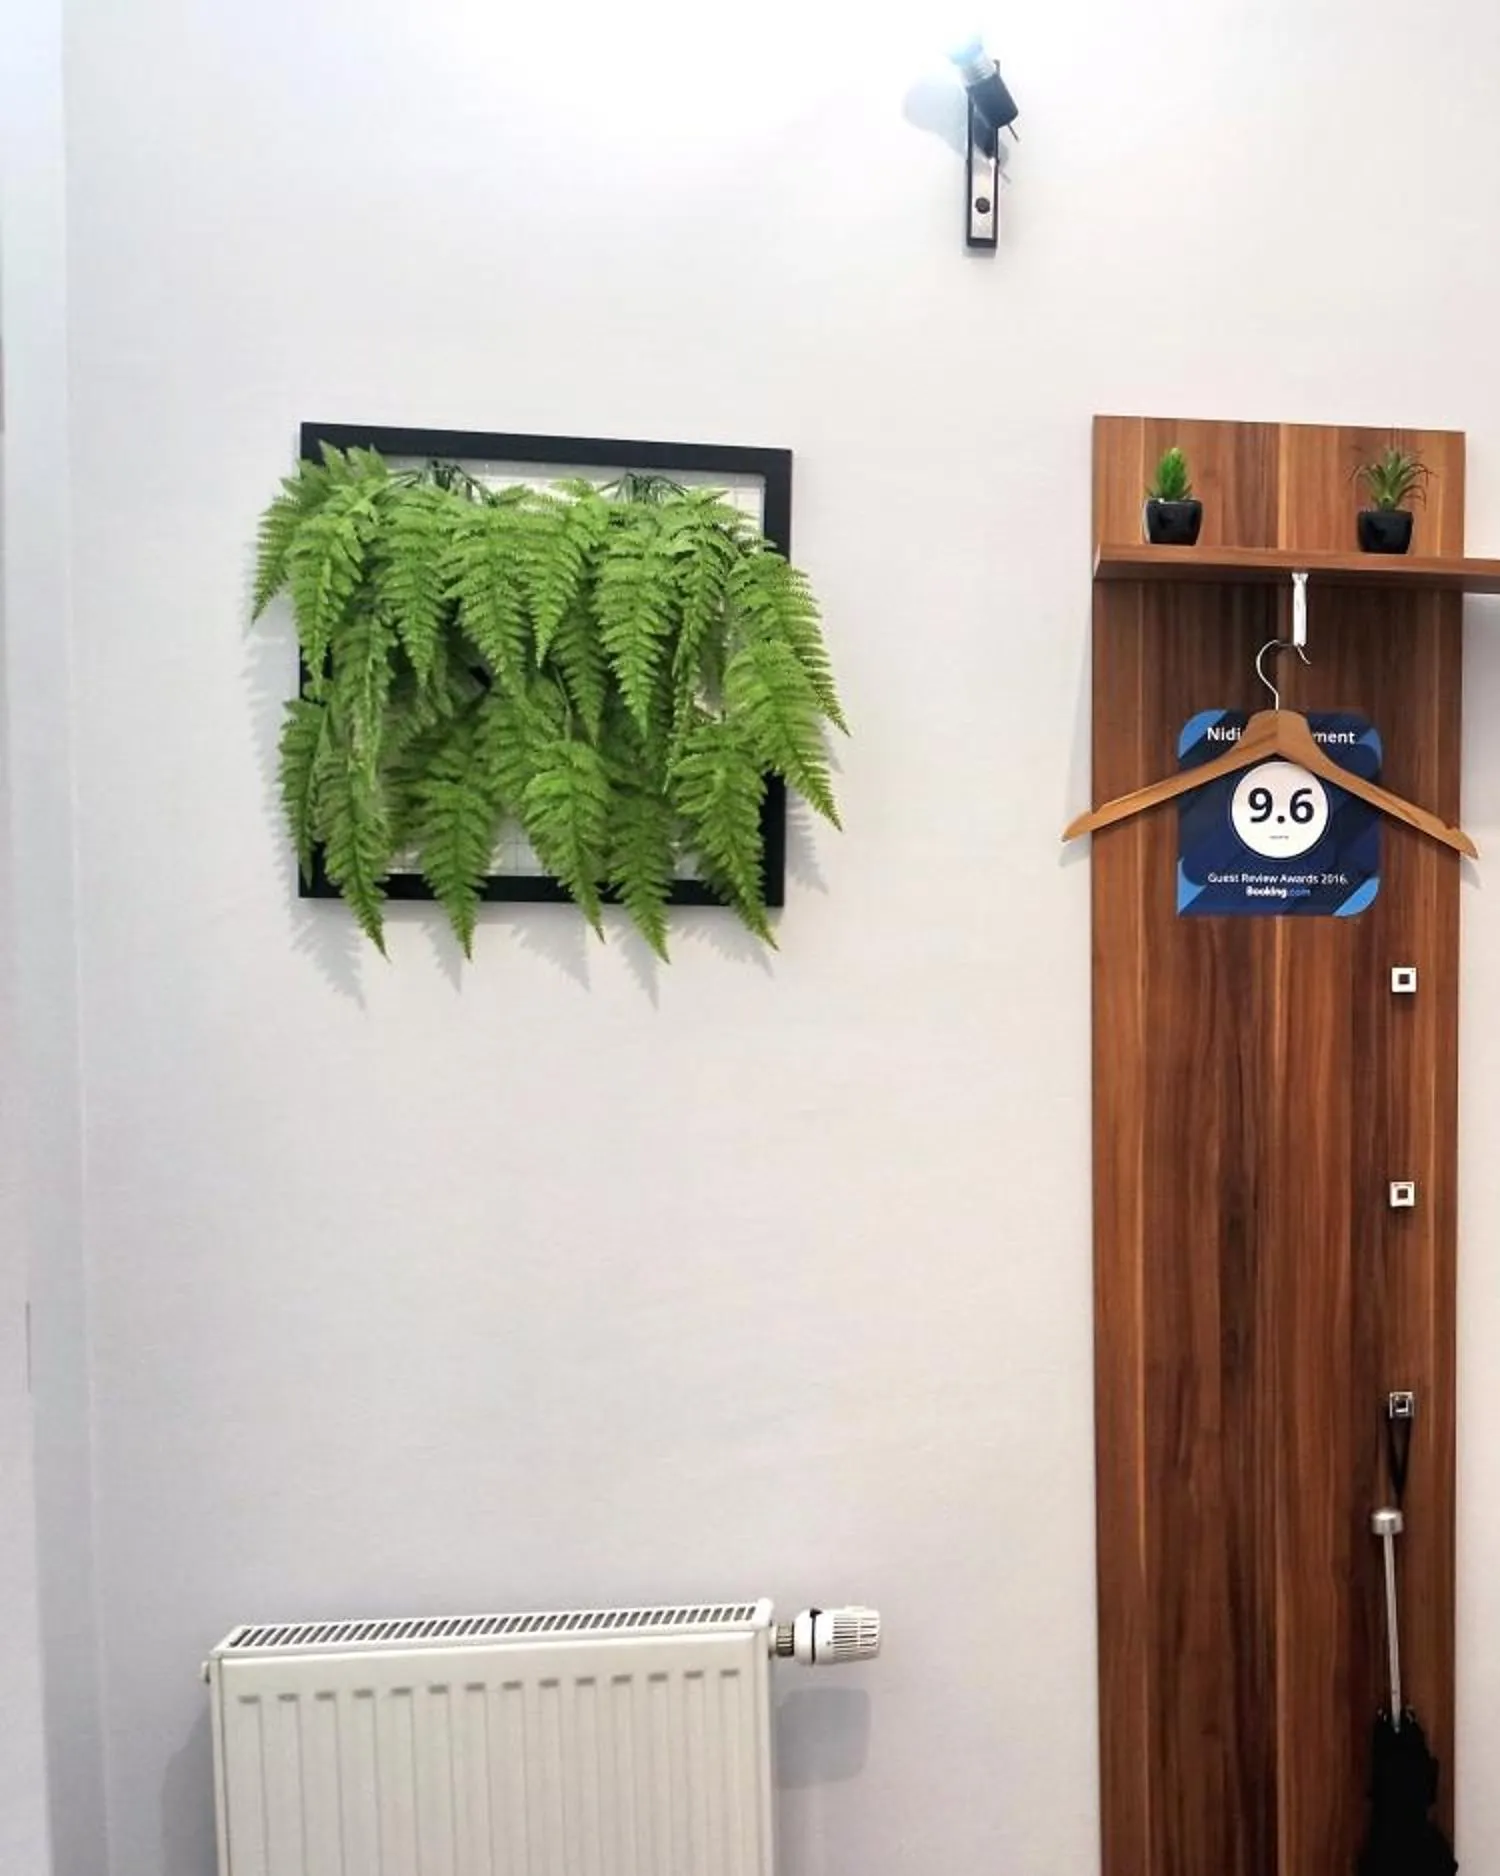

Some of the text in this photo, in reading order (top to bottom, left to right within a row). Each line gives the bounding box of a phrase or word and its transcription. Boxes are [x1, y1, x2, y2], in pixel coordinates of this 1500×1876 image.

[1248, 787, 1315, 825] 9.6
[1207, 872, 1239, 883] Guest
[1241, 872, 1278, 884] Review
[1279, 873, 1319, 885] Awards
[1245, 886, 1311, 899] Booking.com
